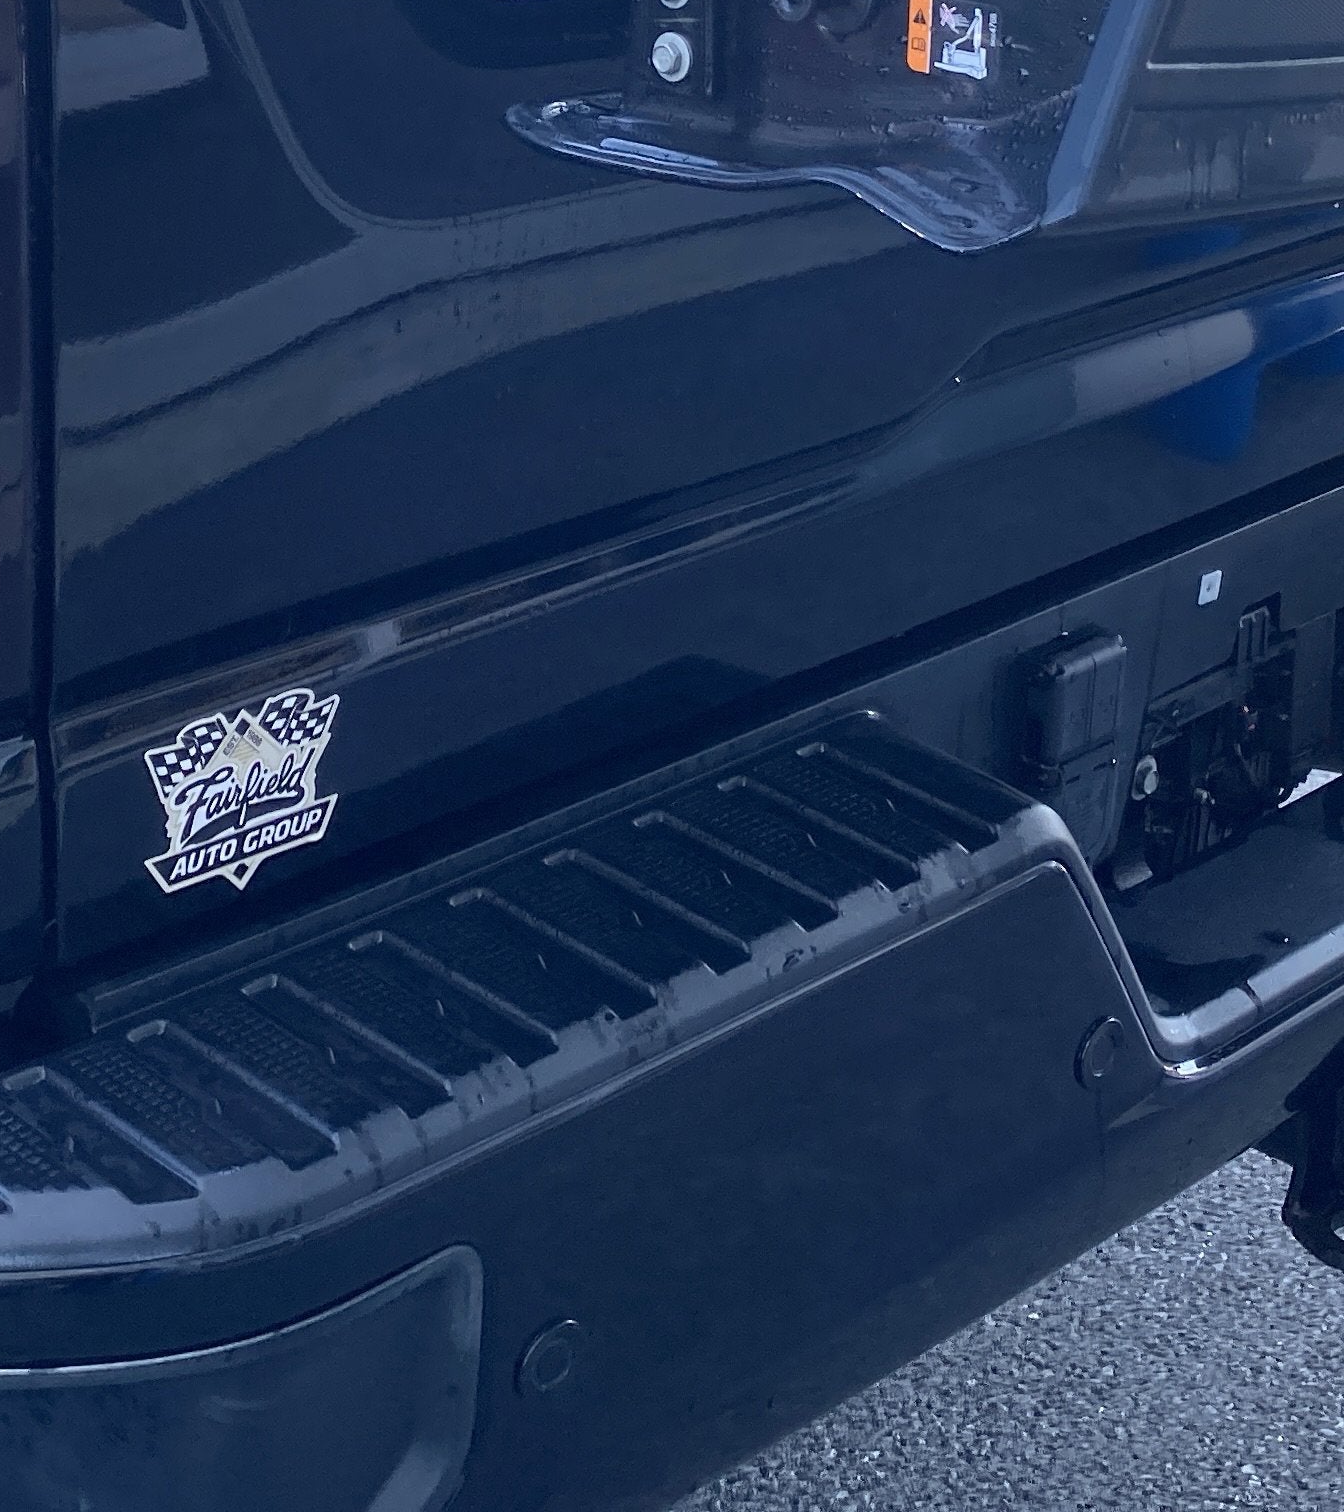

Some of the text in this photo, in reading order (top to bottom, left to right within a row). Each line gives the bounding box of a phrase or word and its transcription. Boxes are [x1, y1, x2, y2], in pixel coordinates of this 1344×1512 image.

[174, 747, 316, 843] Fairfield
[169, 808, 323, 881] AUTO GROUP
